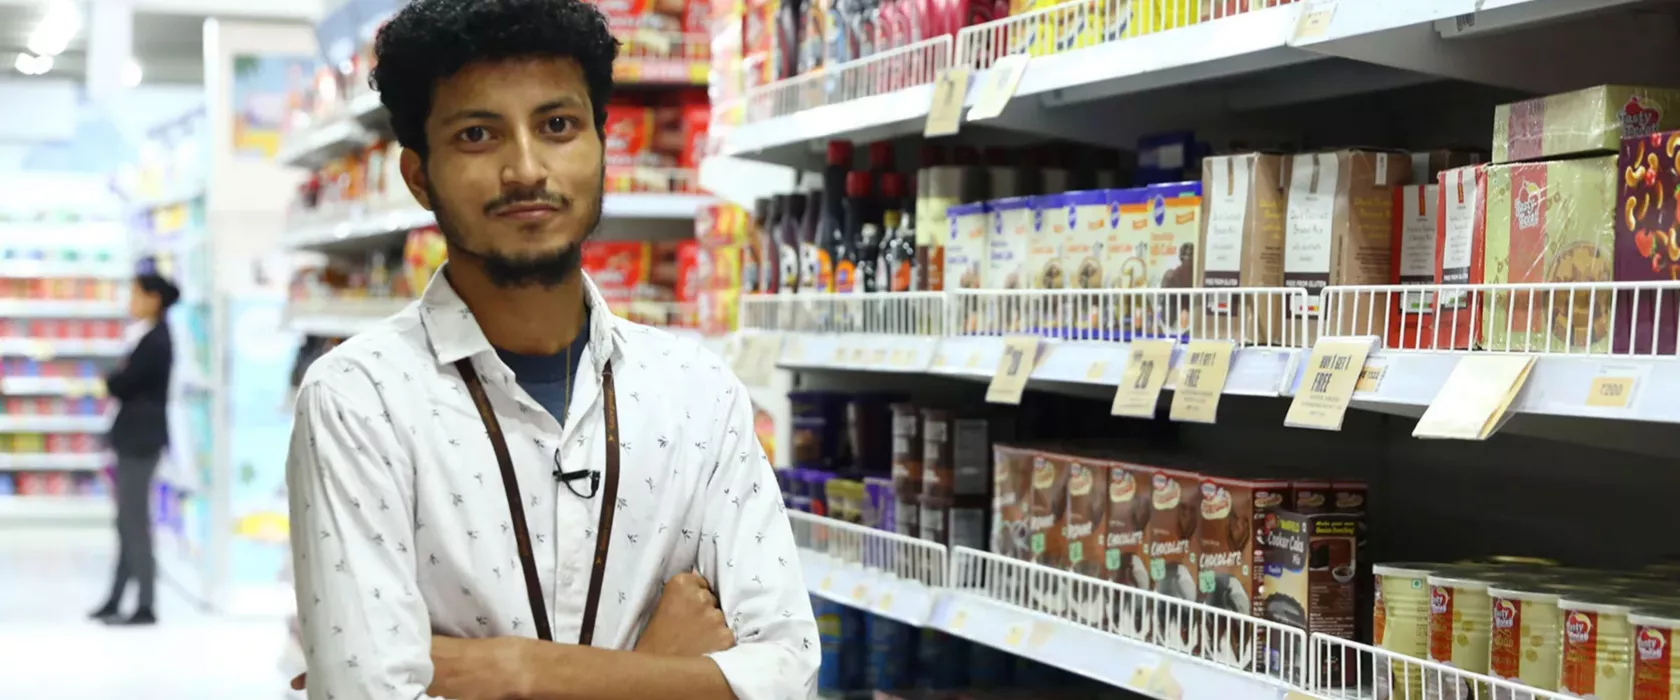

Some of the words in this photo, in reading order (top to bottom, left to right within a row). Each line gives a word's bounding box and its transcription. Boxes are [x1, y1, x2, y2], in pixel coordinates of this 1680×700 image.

[1319, 355, 1332, 369] BUY
[1335, 355, 1347, 370] GET
[1311, 372, 1332, 393] FREE
[1107, 530, 1144, 549] CHOCOLATE
[1151, 539, 1189, 559] CHOCOLATE
[1268, 532, 1289, 550] Cooker
[1289, 536, 1304, 553] Cake
[1199, 551, 1242, 571] CHOCOLATE
